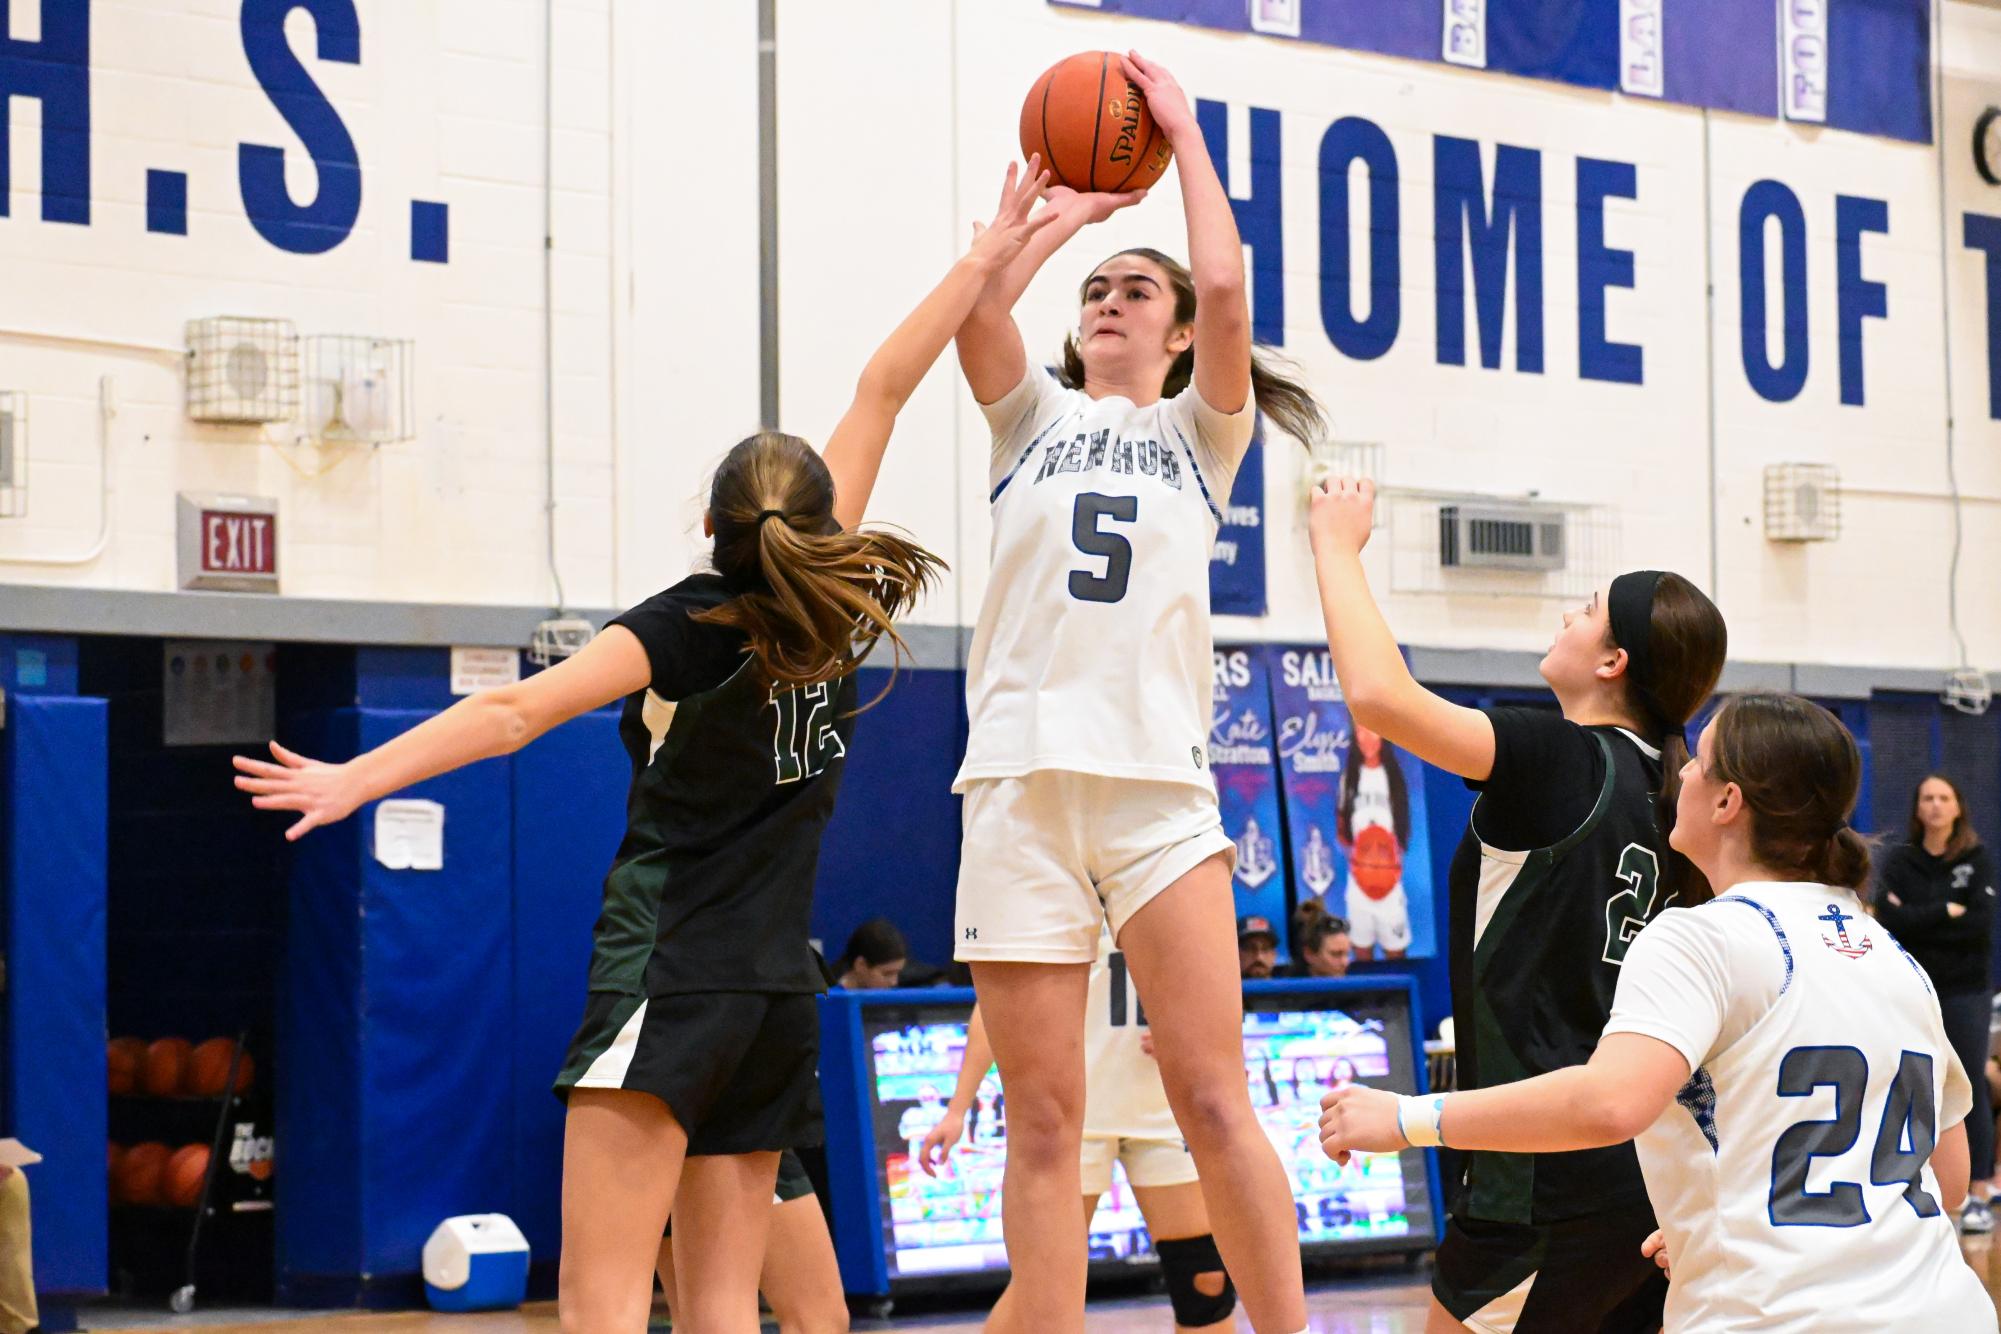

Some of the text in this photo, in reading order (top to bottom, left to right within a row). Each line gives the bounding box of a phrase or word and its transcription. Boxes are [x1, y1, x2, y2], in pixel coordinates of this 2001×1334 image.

[1196, 98, 1643, 385] HOME
[1739, 179, 1889, 407] OF
[209, 517, 266, 569] EXIT
[1068, 492, 1138, 604] 5
[1768, 1045, 1941, 1226] 24
